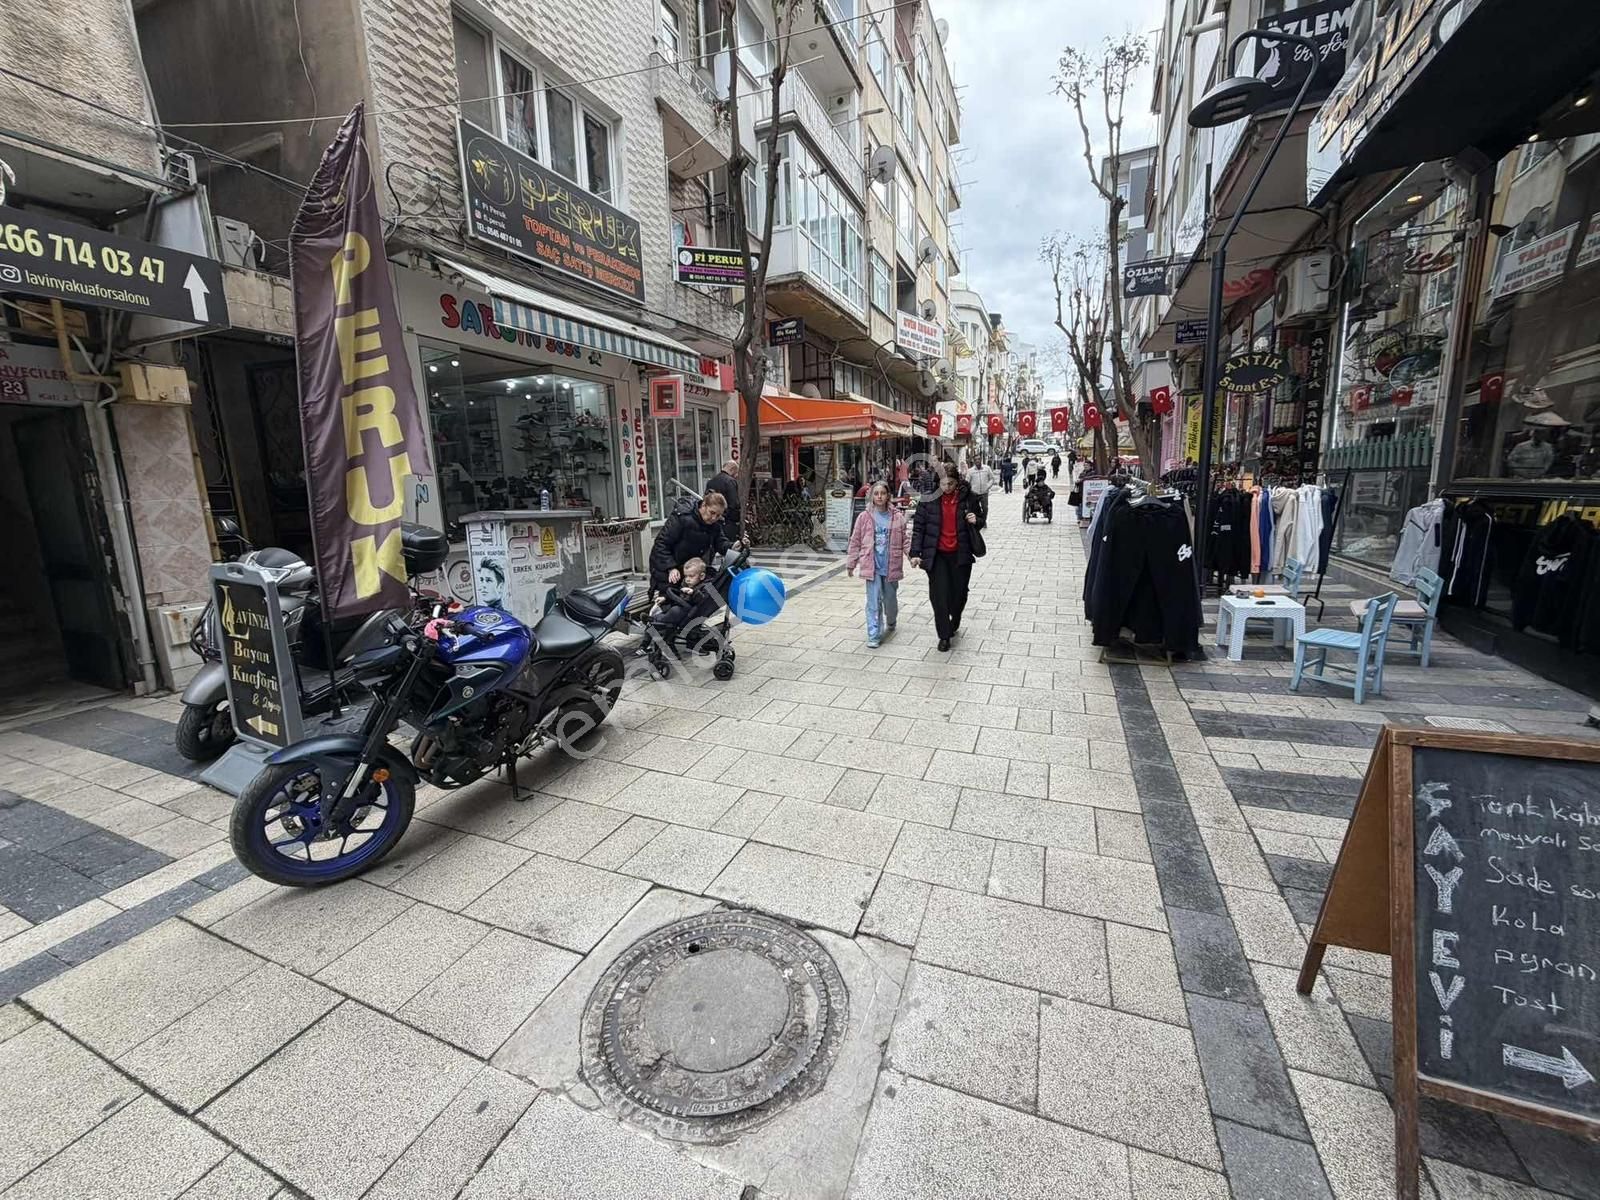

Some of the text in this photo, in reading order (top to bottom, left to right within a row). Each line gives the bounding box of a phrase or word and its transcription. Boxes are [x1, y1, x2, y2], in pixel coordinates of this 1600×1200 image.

[1261, 7, 1350, 48] ÖZLEM
[518, 162, 639, 262] PERUK
[522, 214, 571, 249] TOPTAN
[0, 223, 165, 284] 66 714 03 47
[535, 240, 560, 265] SAÇ
[708, 254, 744, 265] PERUK
[25, 269, 150, 306] lavinyakuaforsalonu
[1126, 266, 1164, 278] ÖZLEM
[1225, 353, 1282, 374] ANTİK
[2, 381, 24, 394] 23
[657, 384, 674, 410] E
[1219, 376, 1257, 392] Sanat
[329, 230, 410, 601] PERUK
[1304, 400, 1318, 450] SANAT
[621, 408, 635, 498] SARGIN
[634, 419, 649, 514] ECZANE
[513, 562, 560, 573] ERKEK KUAFÖRÜ
[233, 640, 270, 665] Bayan
[232, 664, 279, 692] Kuaförü
[1485, 855, 1556, 895] Sade
[1492, 985, 1567, 1016] Tost
